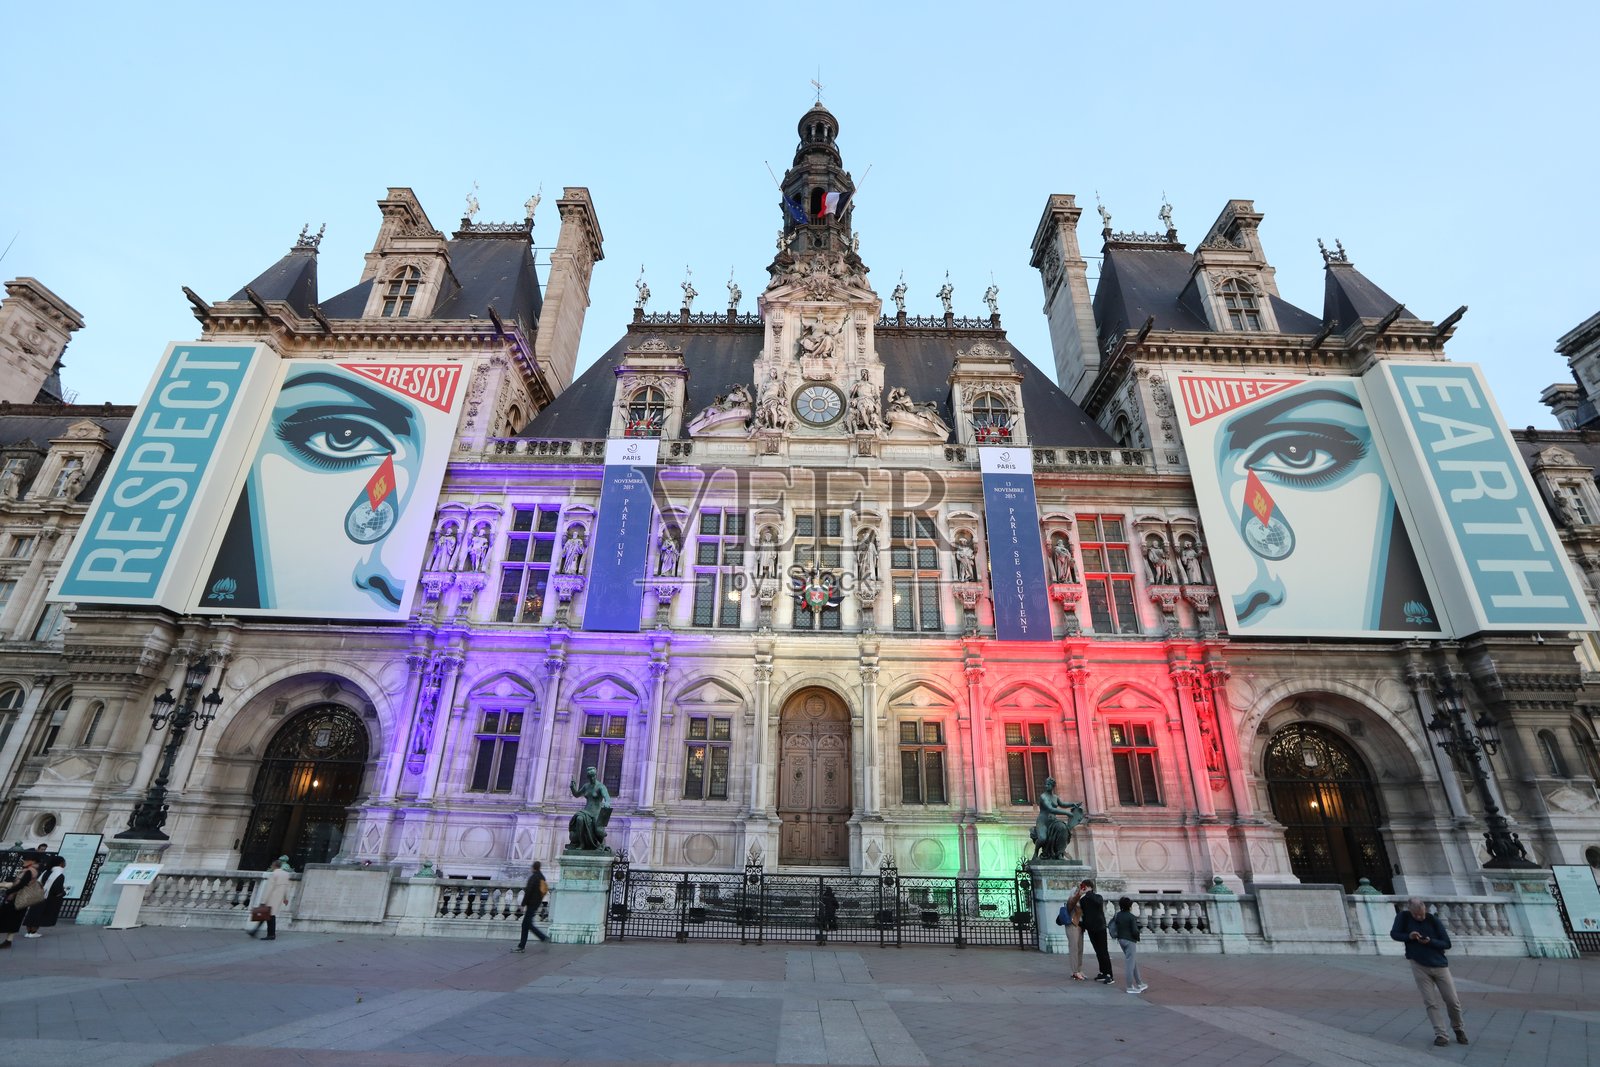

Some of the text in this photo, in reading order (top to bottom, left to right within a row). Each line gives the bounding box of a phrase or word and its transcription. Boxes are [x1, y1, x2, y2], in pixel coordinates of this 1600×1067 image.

[385, 366, 460, 407] RESIST
[1181, 379, 1256, 419] UNITE
[76, 351, 242, 584] RESPECT
[1402, 375, 1570, 608] EARTH
[616, 498, 629, 566] PARIS UNI
[1009, 507, 1028, 634] PARIS SE SOUVIENT
